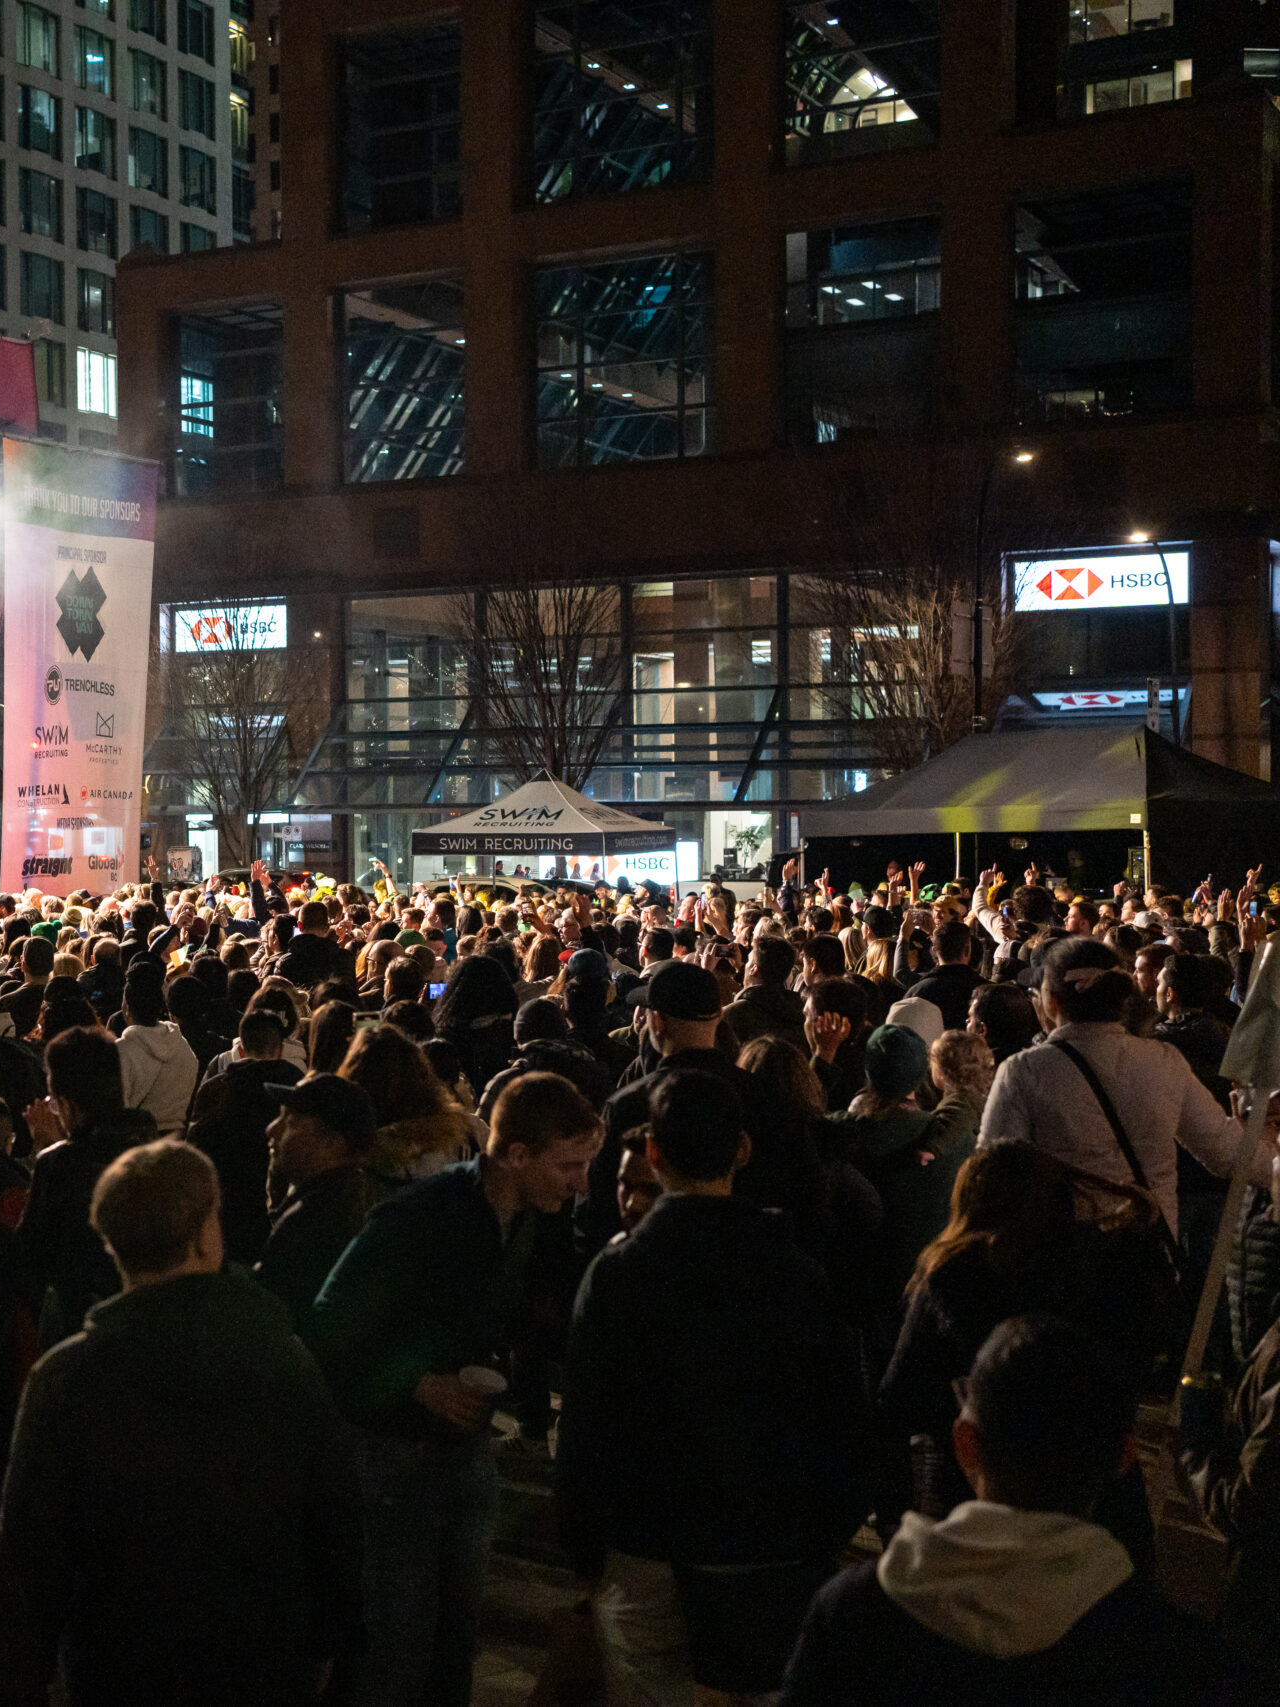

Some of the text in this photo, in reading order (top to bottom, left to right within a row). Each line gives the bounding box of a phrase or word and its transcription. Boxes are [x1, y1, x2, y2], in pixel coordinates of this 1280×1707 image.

[53, 490, 68, 513] YOU
[70, 493, 80, 515] TO
[81, 496, 98, 517] OUR
[100, 498, 141, 522] SPONSORS
[1111, 572, 1169, 588] HSBC
[240, 621, 277, 634] HSBC
[64, 678, 115, 696] TRENCHLESS
[35, 725, 69, 745] SWIM
[34, 749, 69, 759] RECRUITING
[86, 744, 123, 755] McCARTHY
[17, 784, 60, 798] WHELAN
[89, 789, 133, 800] AIR CANADA
[479, 807, 565, 821] SWIM
[439, 837, 574, 850] SWIM RECRUITING
[21, 854, 73, 877] straight
[88, 854, 118, 870] Global
[625, 857, 670, 870] HSBC
